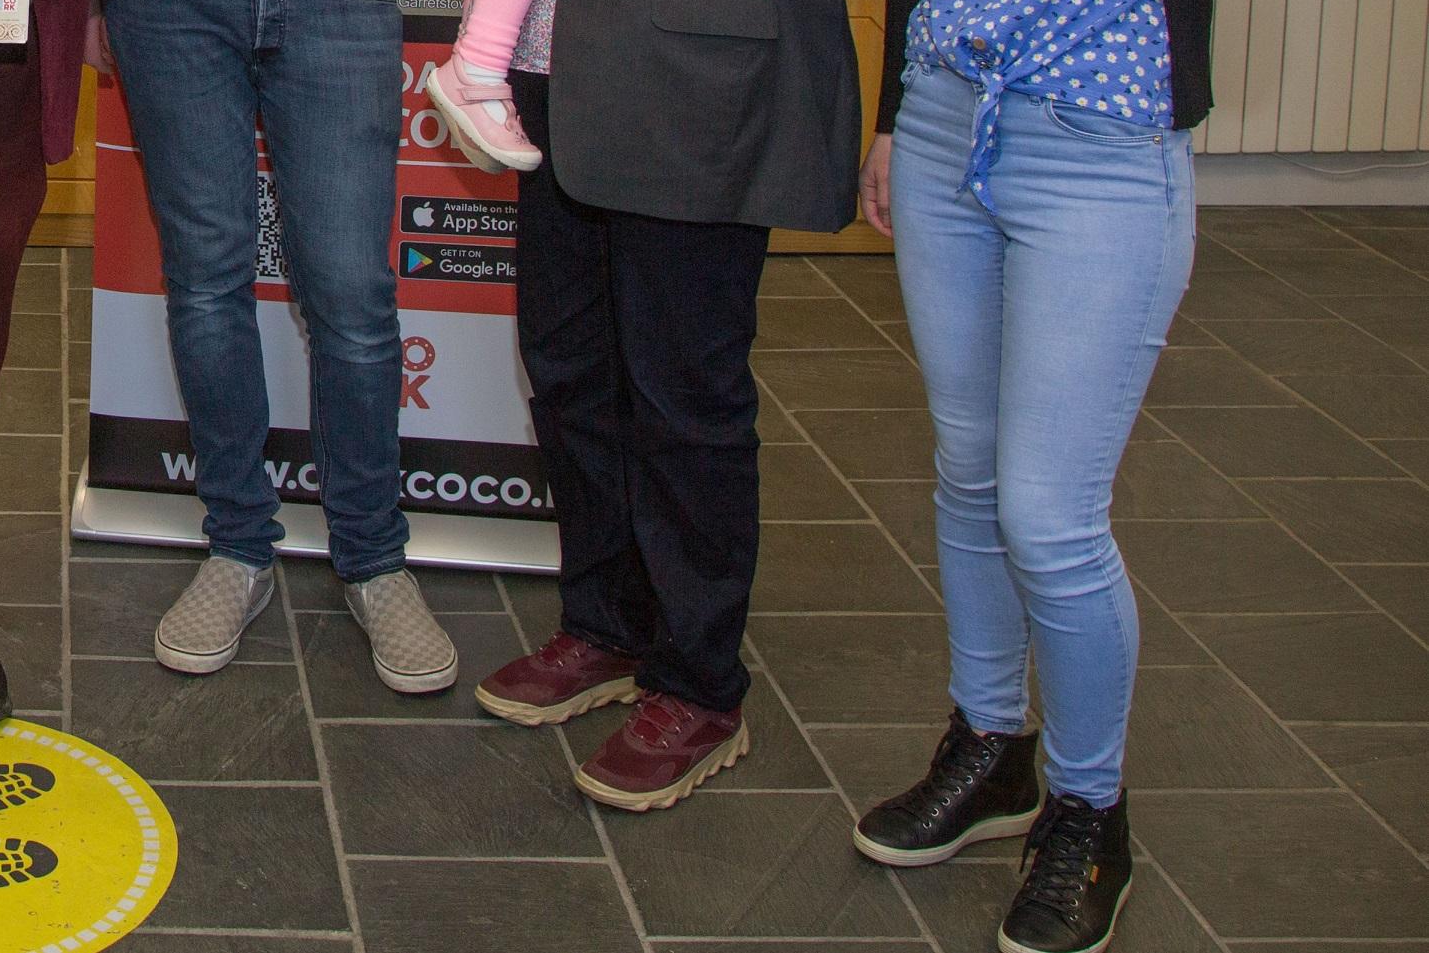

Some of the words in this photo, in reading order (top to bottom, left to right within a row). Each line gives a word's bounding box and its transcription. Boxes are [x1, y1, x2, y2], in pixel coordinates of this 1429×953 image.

[444, 202, 488, 213] Available
[489, 206, 502, 214] on
[442, 214, 478, 233] App
[480, 215, 518, 232] Stor
[440, 248, 458, 257] GET
[459, 249, 467, 257] IT
[467, 250, 482, 258] ON
[439, 258, 494, 278] Google
[496, 262, 517, 277] Pla
